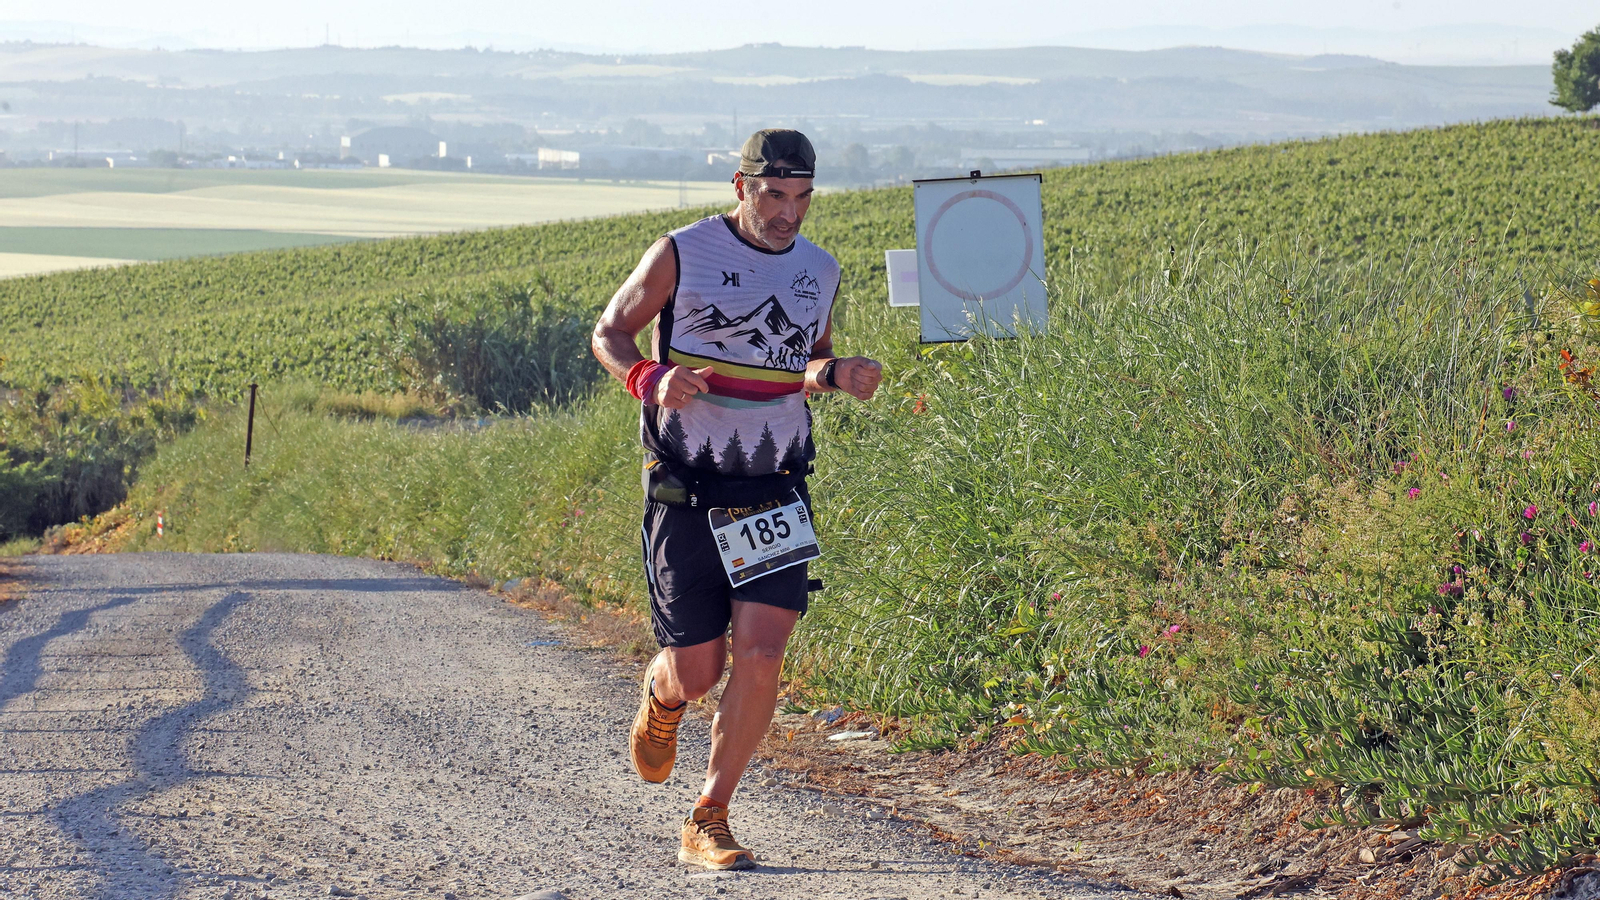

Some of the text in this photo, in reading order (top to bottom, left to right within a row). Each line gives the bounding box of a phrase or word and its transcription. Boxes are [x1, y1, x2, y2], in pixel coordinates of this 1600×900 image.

[740, 512, 791, 550] 185
[762, 543, 782, 553] SERGIO
[758, 551, 780, 561] SANCHEZ
